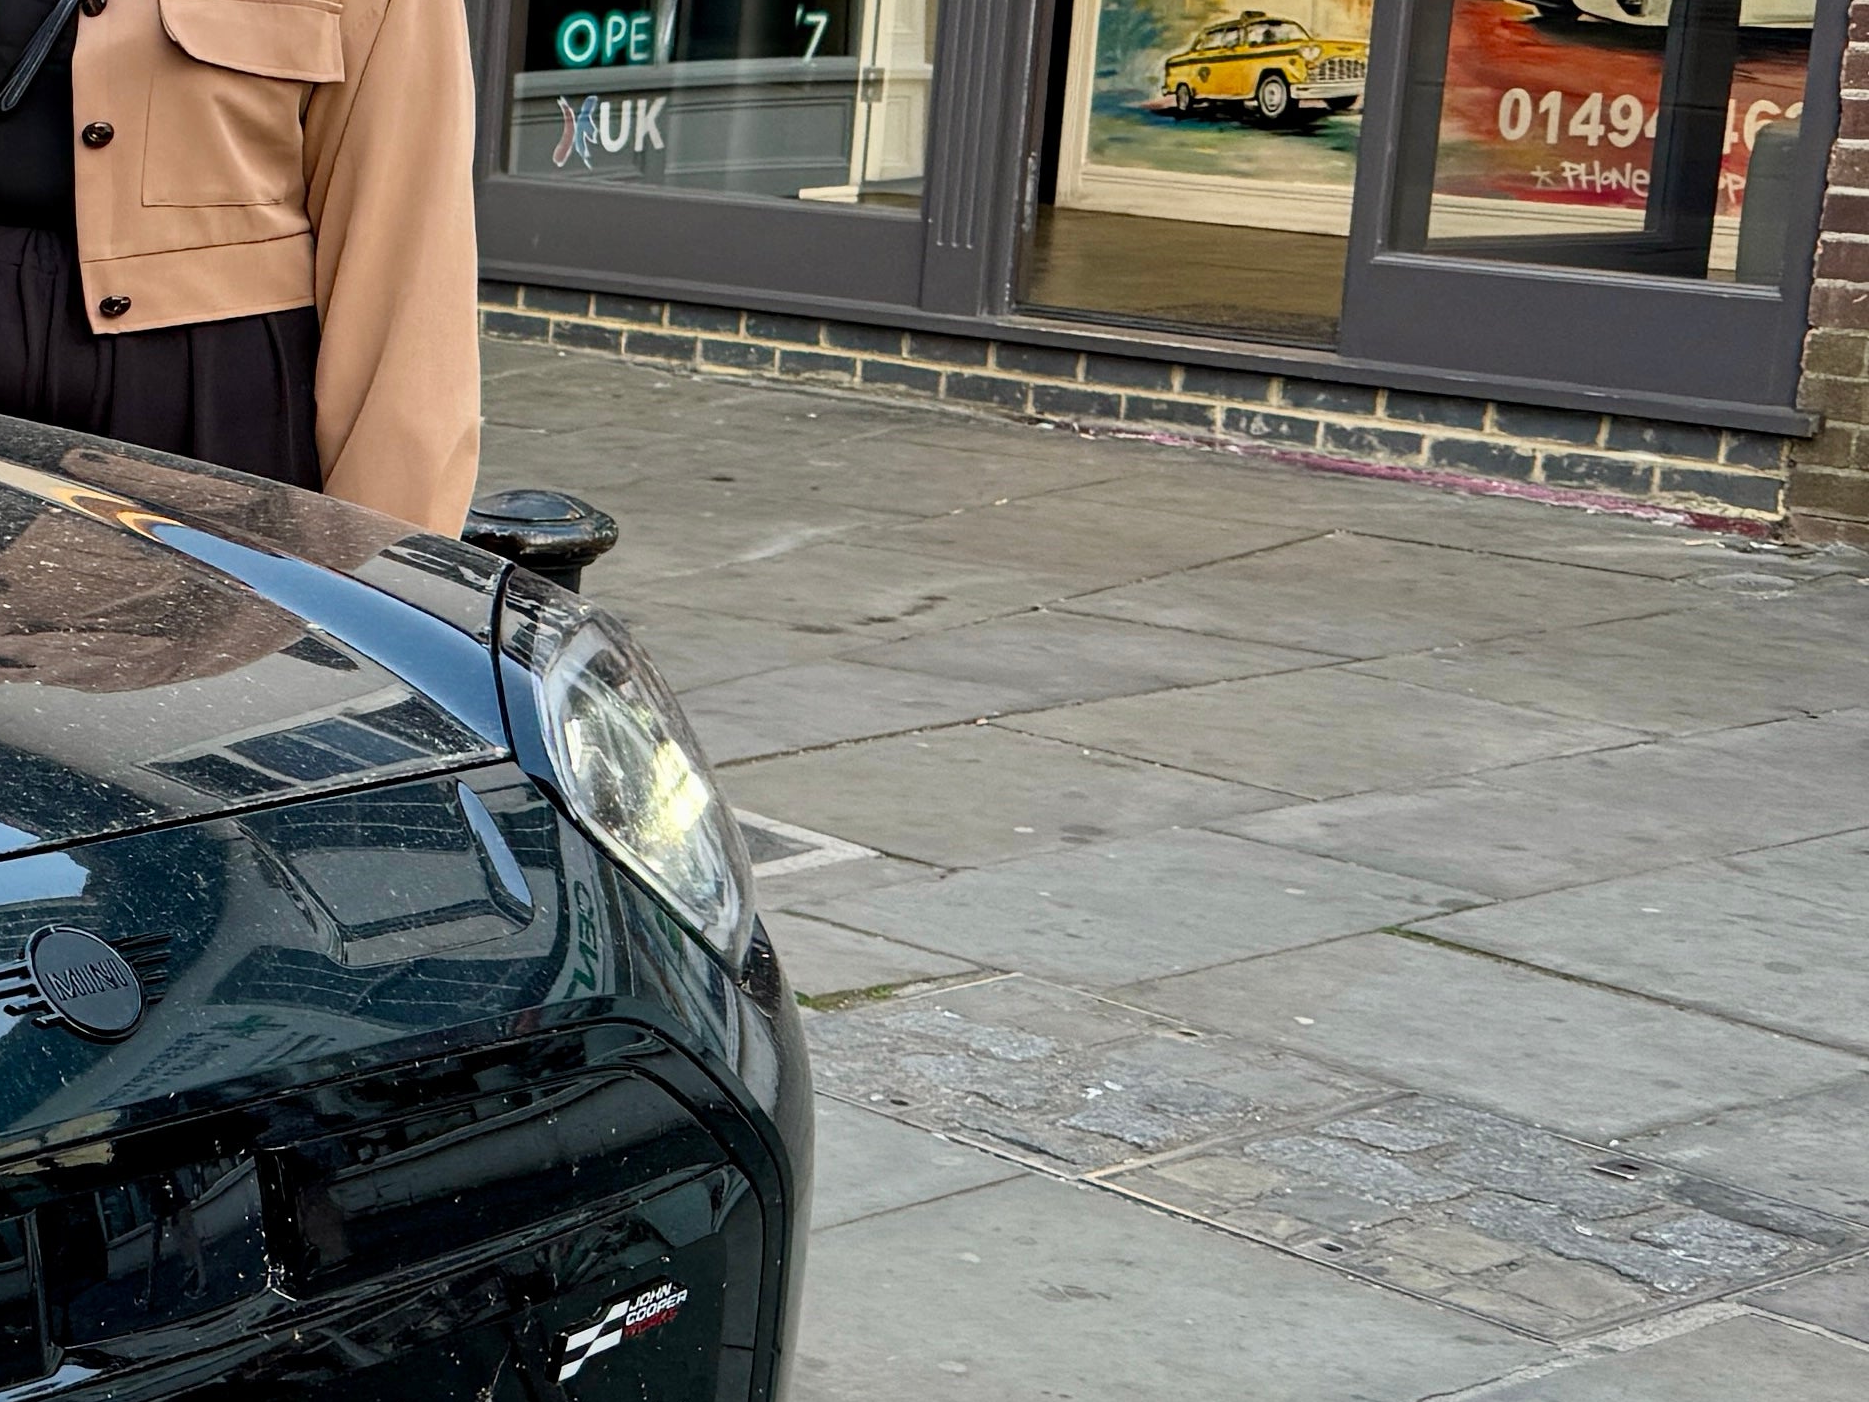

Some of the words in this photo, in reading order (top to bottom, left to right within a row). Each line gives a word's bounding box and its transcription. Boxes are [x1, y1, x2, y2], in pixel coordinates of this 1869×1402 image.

[563, 16, 651, 63] OPE
[45, 959, 129, 1001] MINI
[626, 1289, 688, 1326] COOPER
[629, 1282, 672, 1311] JOHN
